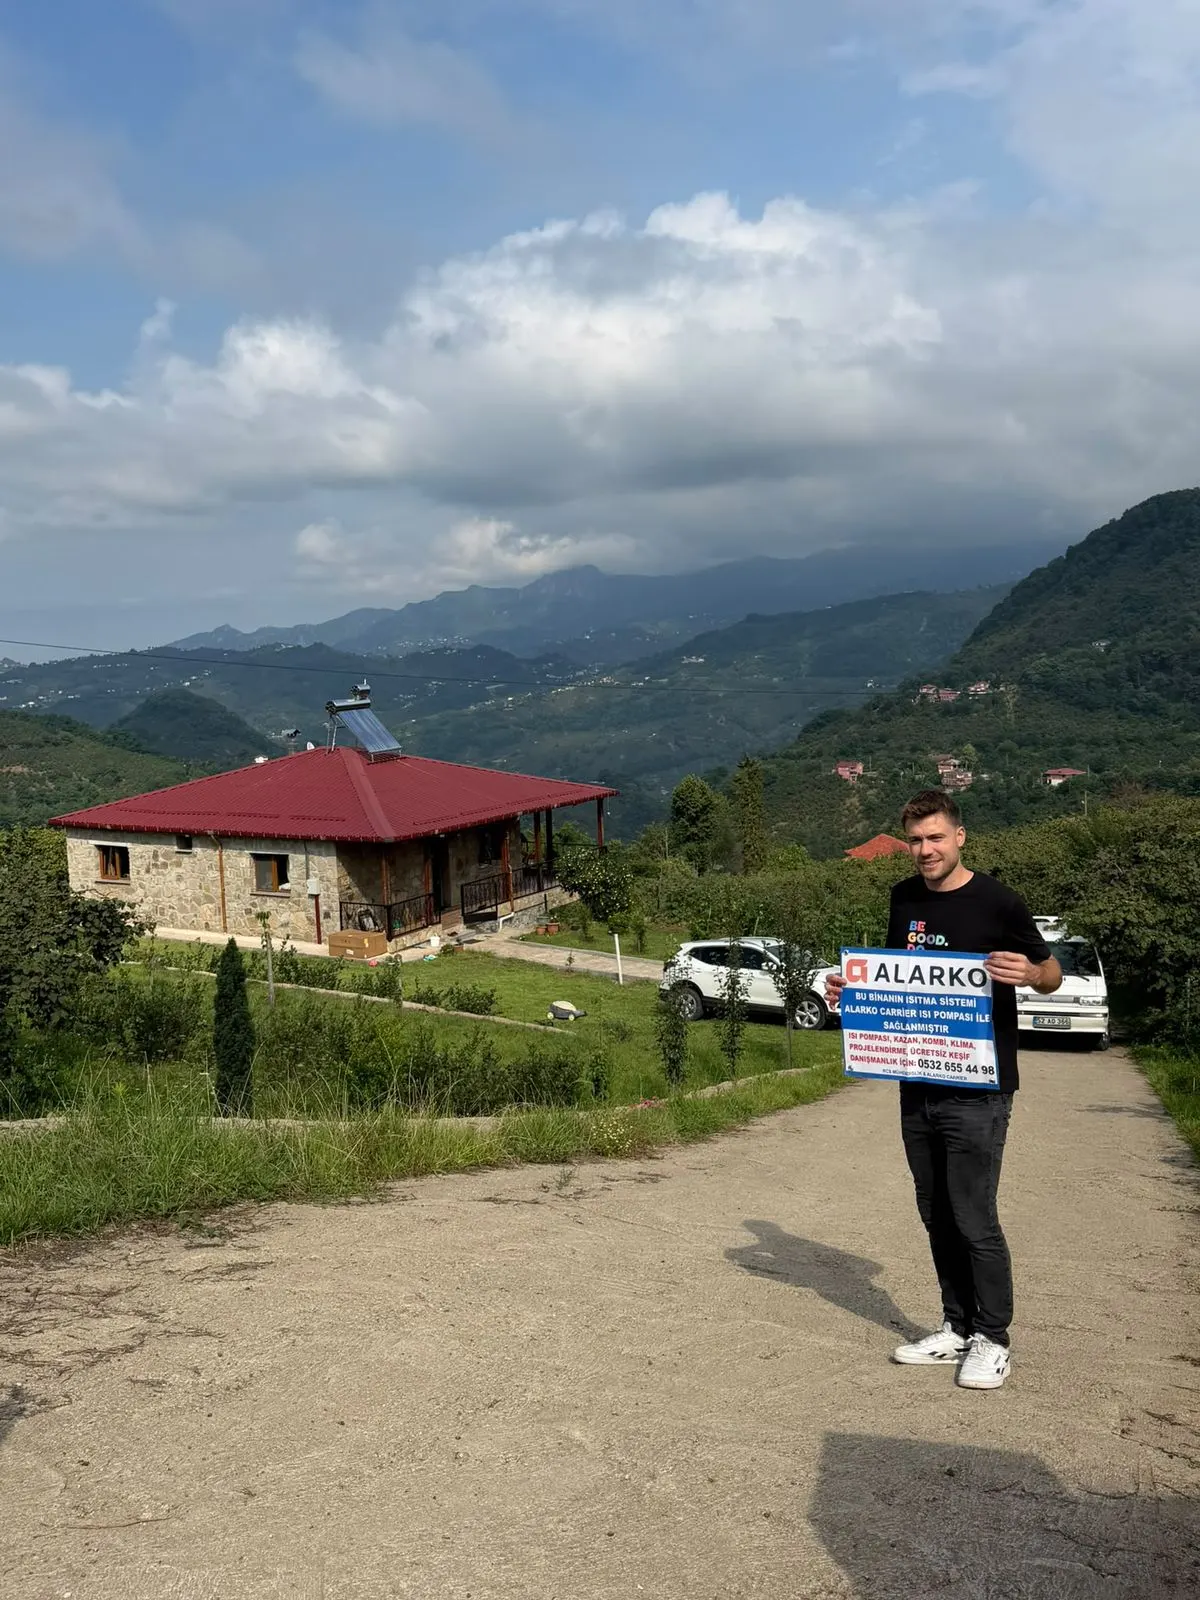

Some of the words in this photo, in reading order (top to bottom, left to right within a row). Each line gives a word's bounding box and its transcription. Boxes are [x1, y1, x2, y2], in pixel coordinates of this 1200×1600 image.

[909, 920, 926, 932] BE
[908, 932, 948, 946] GOOD.
[874, 962, 988, 988] ALARKO
[856, 992, 866, 1000] BU
[869, 992, 904, 1004] BİNANIN
[906, 995, 937, 1006] ISITMA
[940, 996, 976, 1008] SİSTEMİ
[845, 1005, 877, 1015] ALARKO
[919, 1009, 931, 1019] ISI
[934, 1011, 974, 1022] POMPASI
[976, 1012, 990, 1022] İLE
[883, 1021, 949, 1034] SAĞLANMIŞTIR
[860, 1034, 892, 1044] POMPASI,
[894, 1036, 920, 1044] KAZAN,
[922, 1038, 948, 1047] KOMBİ,
[850, 1044, 908, 1056] PROJELENDİRME,
[910, 1048, 947, 1057] ÜCRETSİZ
[949, 1051, 970, 1061] KEŞİF
[850, 1055, 898, 1065] DANIŞMANLIK
[899, 1058, 916, 1068] İÇİN:
[918, 1059, 941, 1070] 0532
[944, 1062, 962, 1072] 655
[965, 1064, 979, 1074] 44
[981, 1066, 995, 1075] 98
